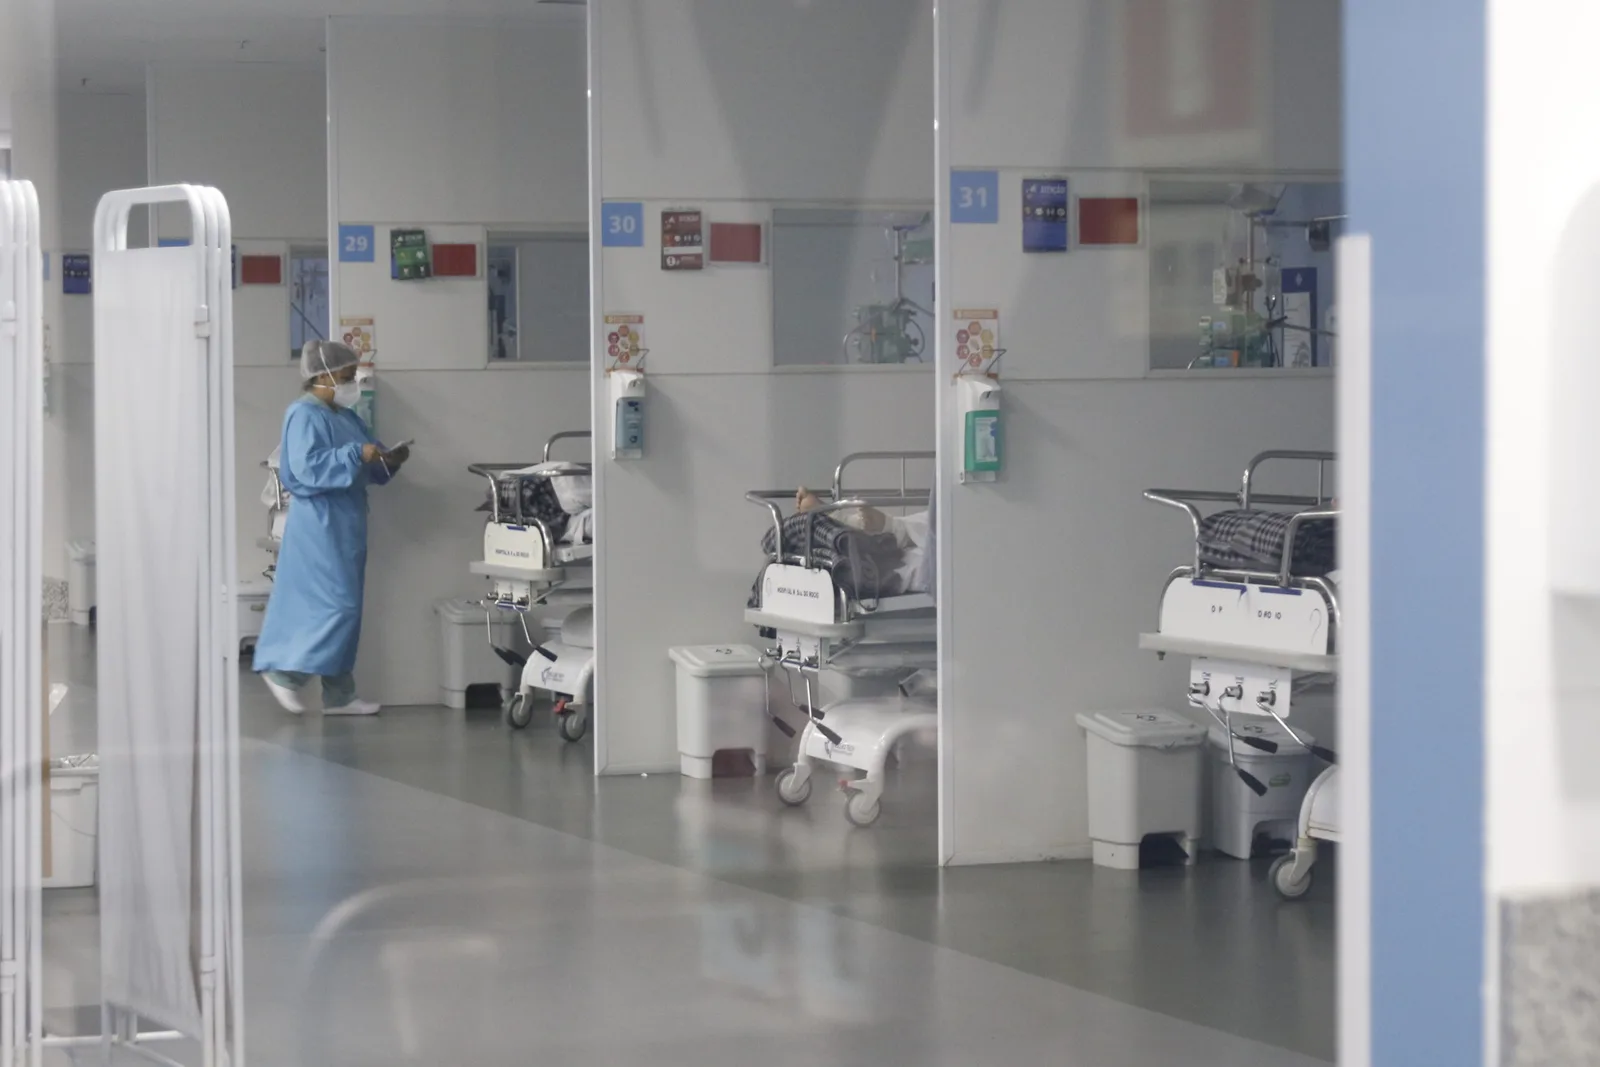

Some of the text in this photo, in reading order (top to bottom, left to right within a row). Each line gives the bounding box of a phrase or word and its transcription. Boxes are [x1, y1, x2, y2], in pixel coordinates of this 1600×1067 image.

[958, 186, 988, 208] 31
[608, 215, 636, 234] 30
[344, 236, 368, 252] 29
